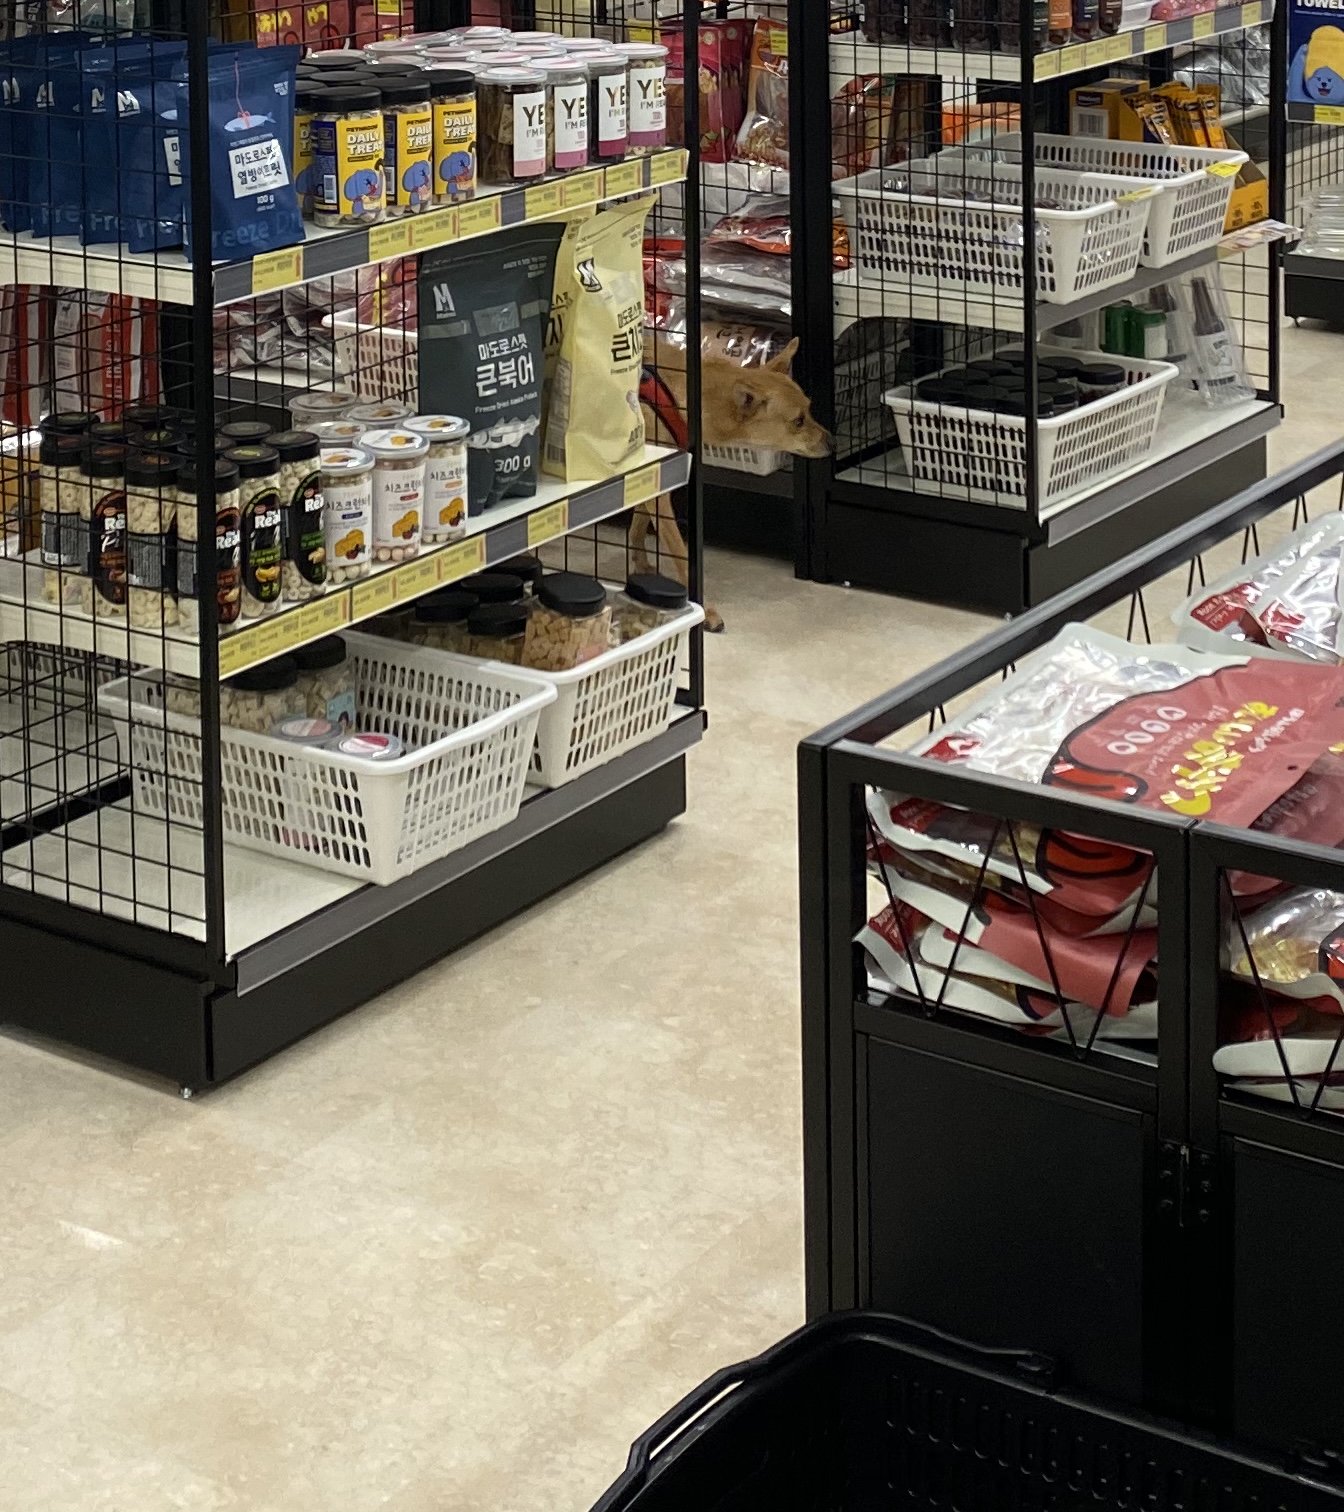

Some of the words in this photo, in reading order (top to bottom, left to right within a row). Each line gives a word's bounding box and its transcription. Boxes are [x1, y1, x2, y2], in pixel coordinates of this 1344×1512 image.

[443, 115, 475, 128] DAILY
[346, 131, 381, 145] DAILY
[237, 161, 283, 185] 열빙어트릿
[211, 219, 270, 250] reeze
[477, 332, 529, 361] 마도로스펫
[475, 351, 535, 398] 큰북어
[474, 402, 496, 414] Freeze
[494, 454, 521, 474] 300
[522, 454, 532, 470] g
